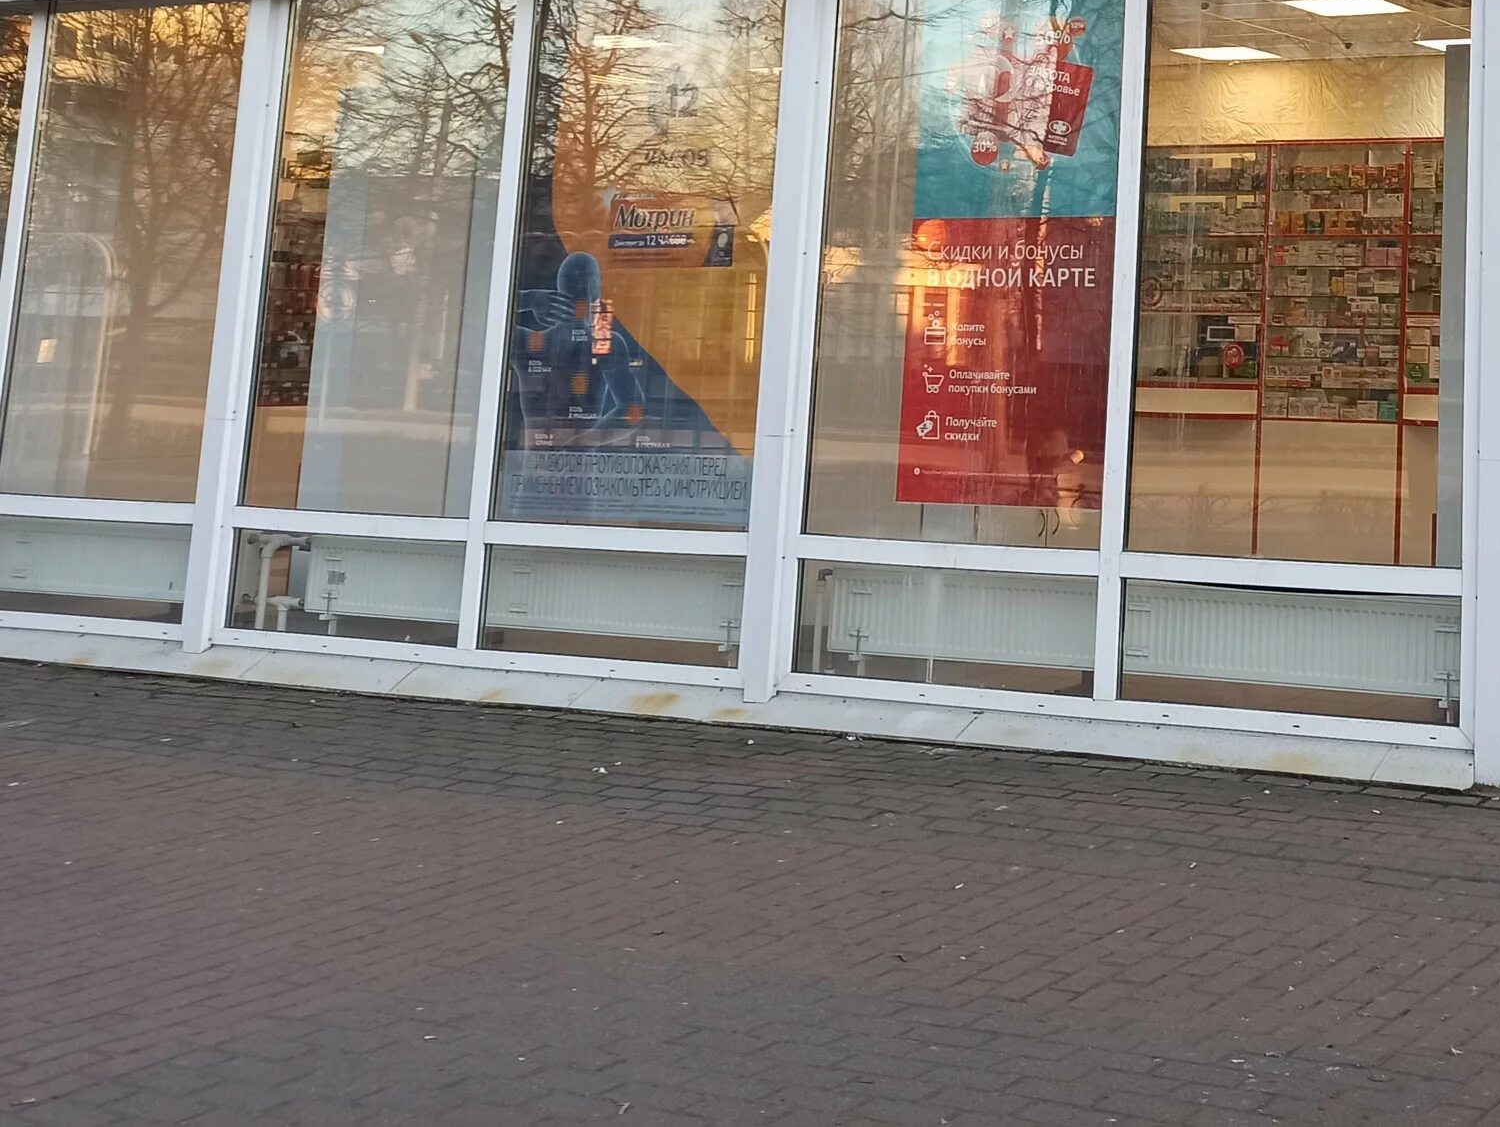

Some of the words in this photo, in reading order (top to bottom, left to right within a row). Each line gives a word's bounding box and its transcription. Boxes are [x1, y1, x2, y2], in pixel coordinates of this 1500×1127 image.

[972, 140, 998, 153] 30%
[615, 204, 696, 233] Мотрин
[927, 241, 992, 262] Скидки
[998, 245, 1009, 259] и
[1014, 239, 1083, 265] бонусы
[946, 262, 1022, 290] ОДНОЙ
[1029, 268, 1096, 288] КАРТЕ
[949, 369, 1010, 380] Оплачивайте
[948, 383, 988, 396] покупки
[990, 383, 1037, 396] бонусами
[945, 416, 997, 429] Получайте
[944, 432, 980, 442] скидки
[695, 456, 728, 480] ПЕРЕД
[664, 478, 673, 499] С
